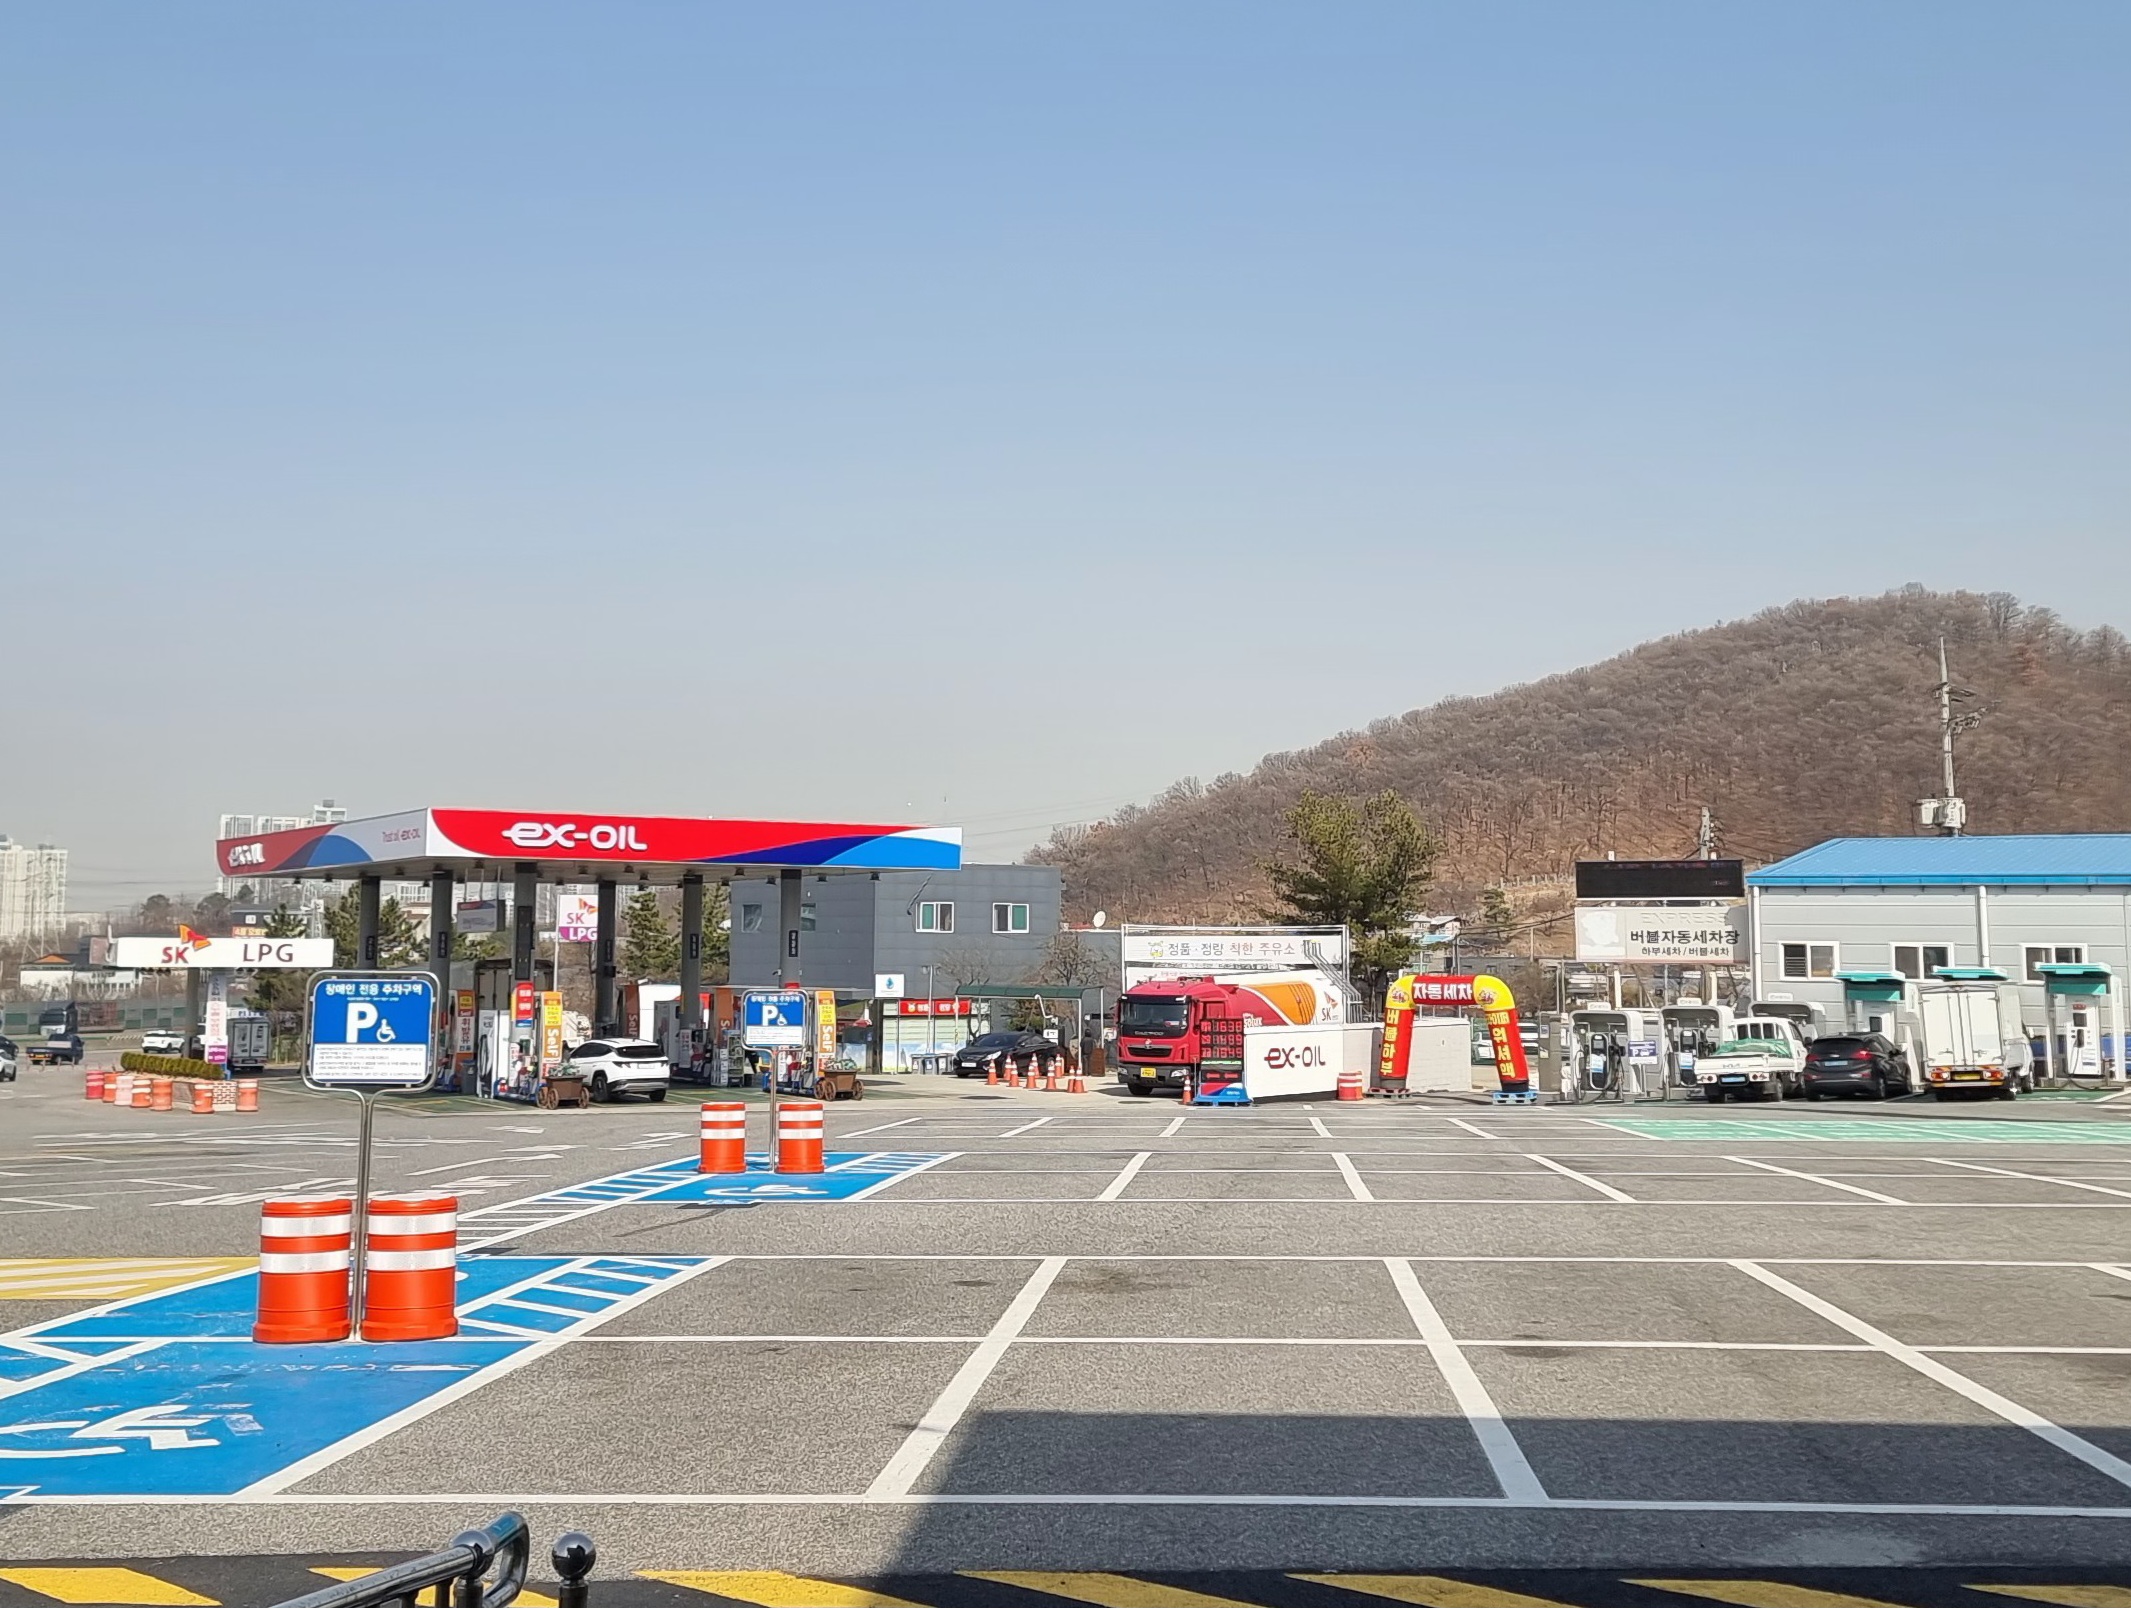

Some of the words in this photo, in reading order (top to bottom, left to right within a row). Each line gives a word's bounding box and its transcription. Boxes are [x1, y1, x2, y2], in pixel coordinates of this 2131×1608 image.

[566, 913, 585, 925] SK
[569, 927, 598, 941] LPG
[1630, 930, 1740, 945] 버블자동세차장
[161, 946, 190, 964] SK
[243, 944, 294, 963] LPG
[1259, 942, 1296, 956] 주유소
[325, 983, 356, 996] 장애인
[359, 983, 379, 996] 전용
[382, 983, 423, 996] 주차구역
[1412, 983, 1472, 1000] 자동세차
[762, 1005, 779, 1027] P
[1321, 1007, 1331, 1022] SK
[345, 1002, 379, 1043] P
